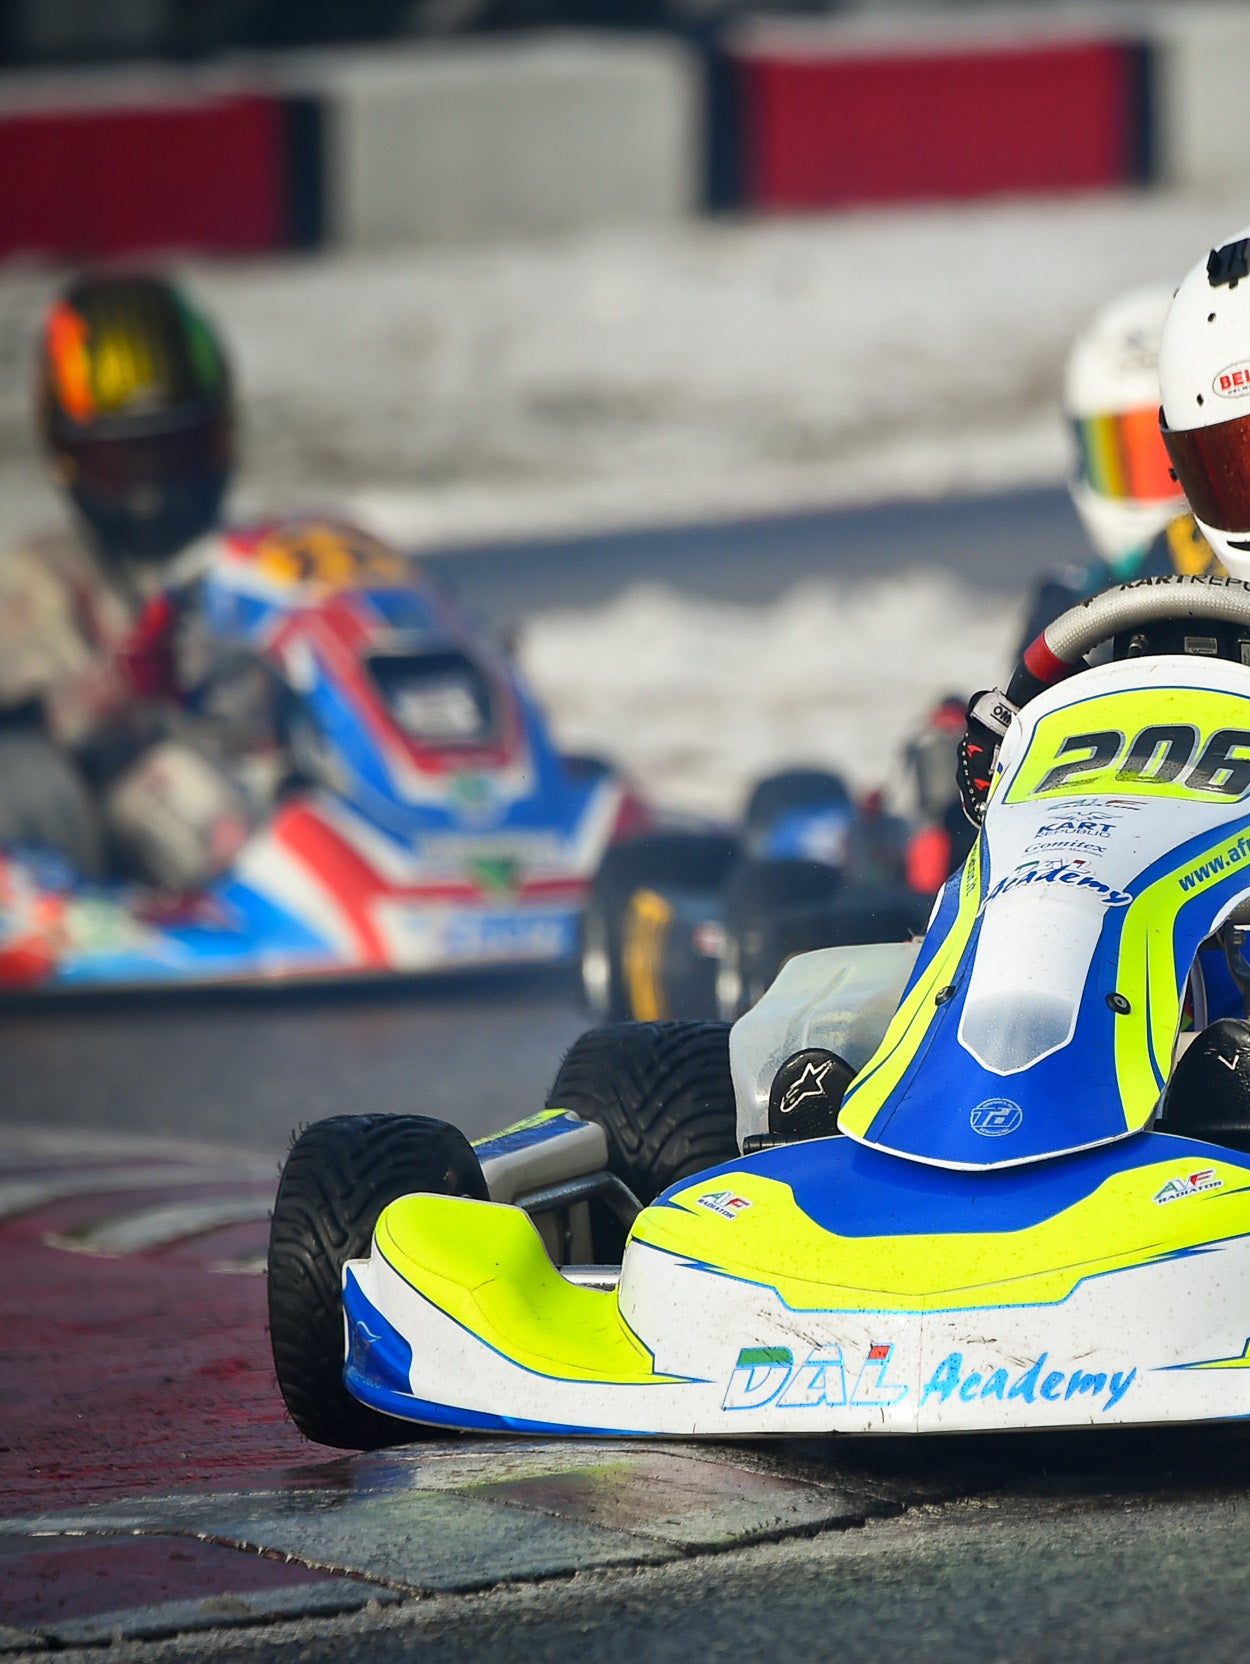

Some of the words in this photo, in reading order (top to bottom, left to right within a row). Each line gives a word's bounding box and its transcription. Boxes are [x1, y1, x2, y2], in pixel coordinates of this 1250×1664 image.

[993, 705, 1012, 725] OM
[1037, 821, 1117, 834] KART
[1025, 840, 1108, 853] Gomitex
[721, 1342, 909, 1412] DAL
[917, 1351, 1138, 1413] Academy
